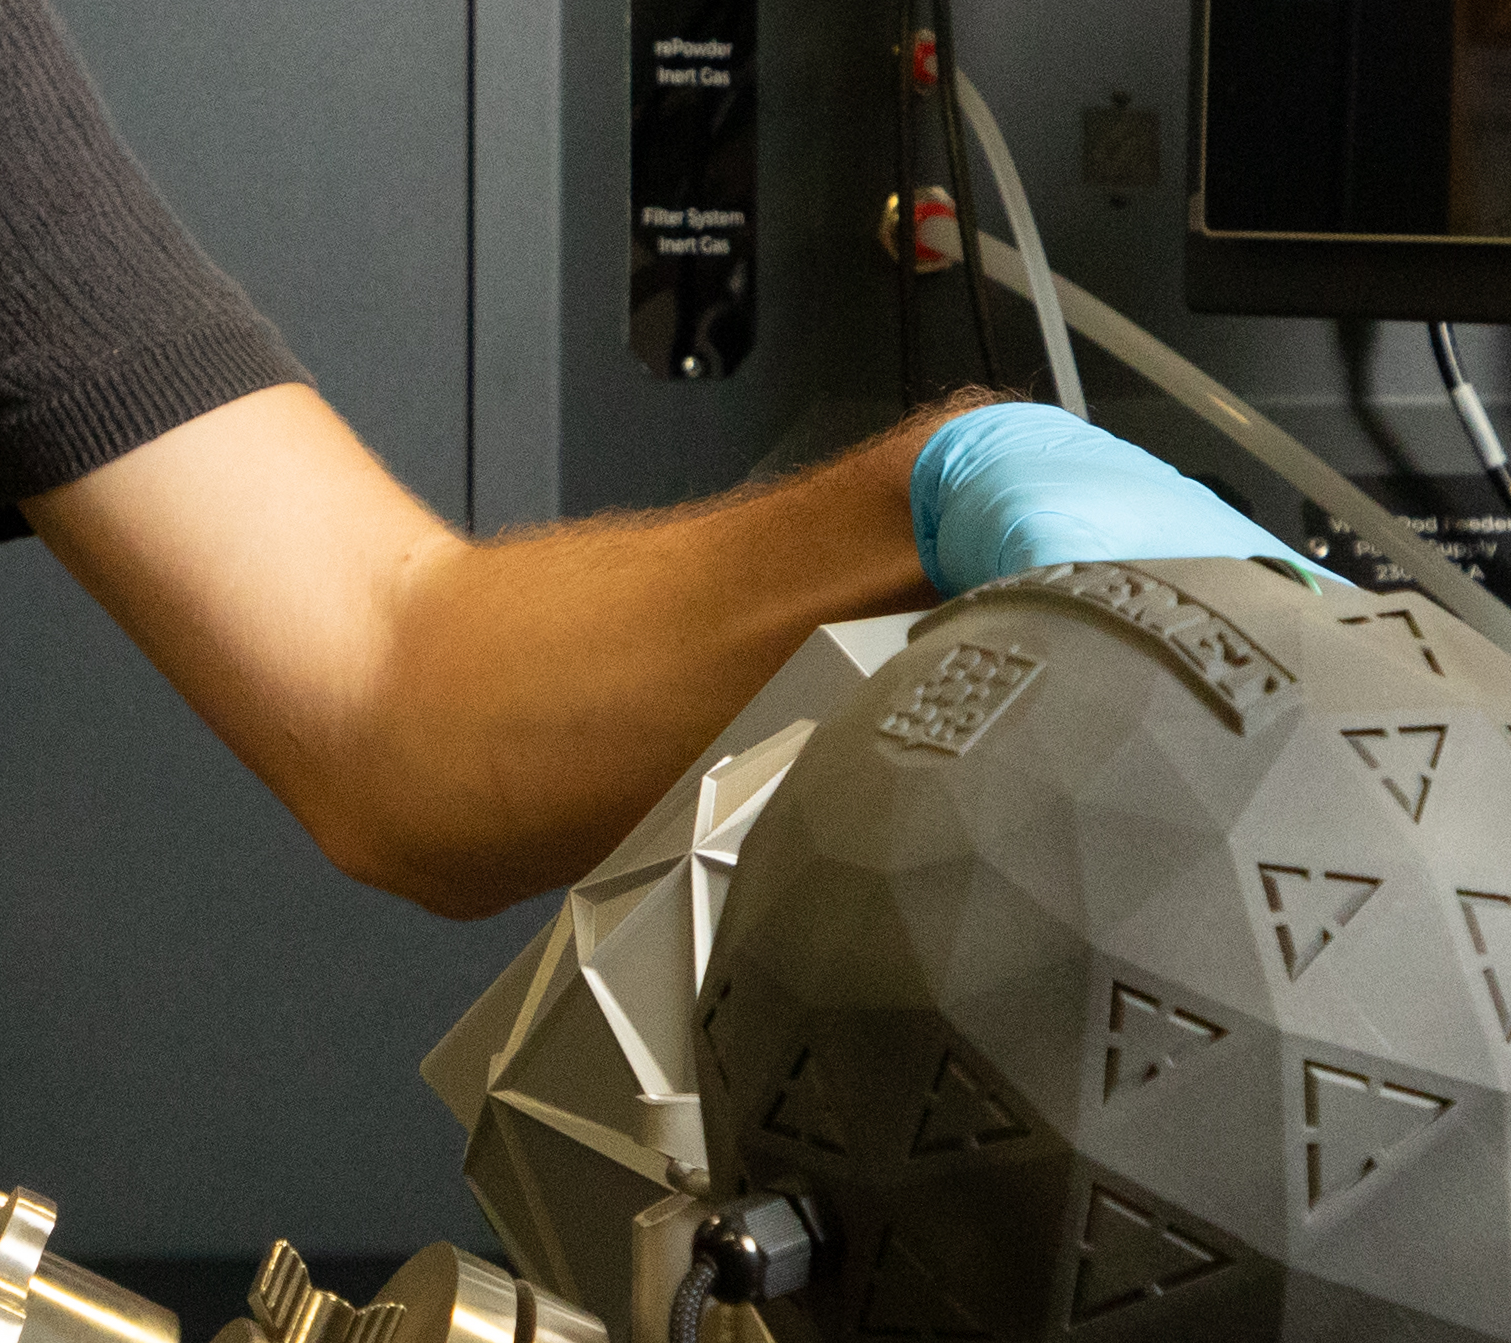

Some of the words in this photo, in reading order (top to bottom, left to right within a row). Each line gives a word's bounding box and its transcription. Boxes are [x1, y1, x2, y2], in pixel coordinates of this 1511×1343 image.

[653, 37, 733, 58] rePowder
[656, 65, 697, 85] Inert
[700, 66, 731, 87] Gas
[641, 207, 684, 227] Filter
[686, 207, 745, 230] System
[656, 236, 697, 255] Inert
[699, 235, 731, 255] Gas
